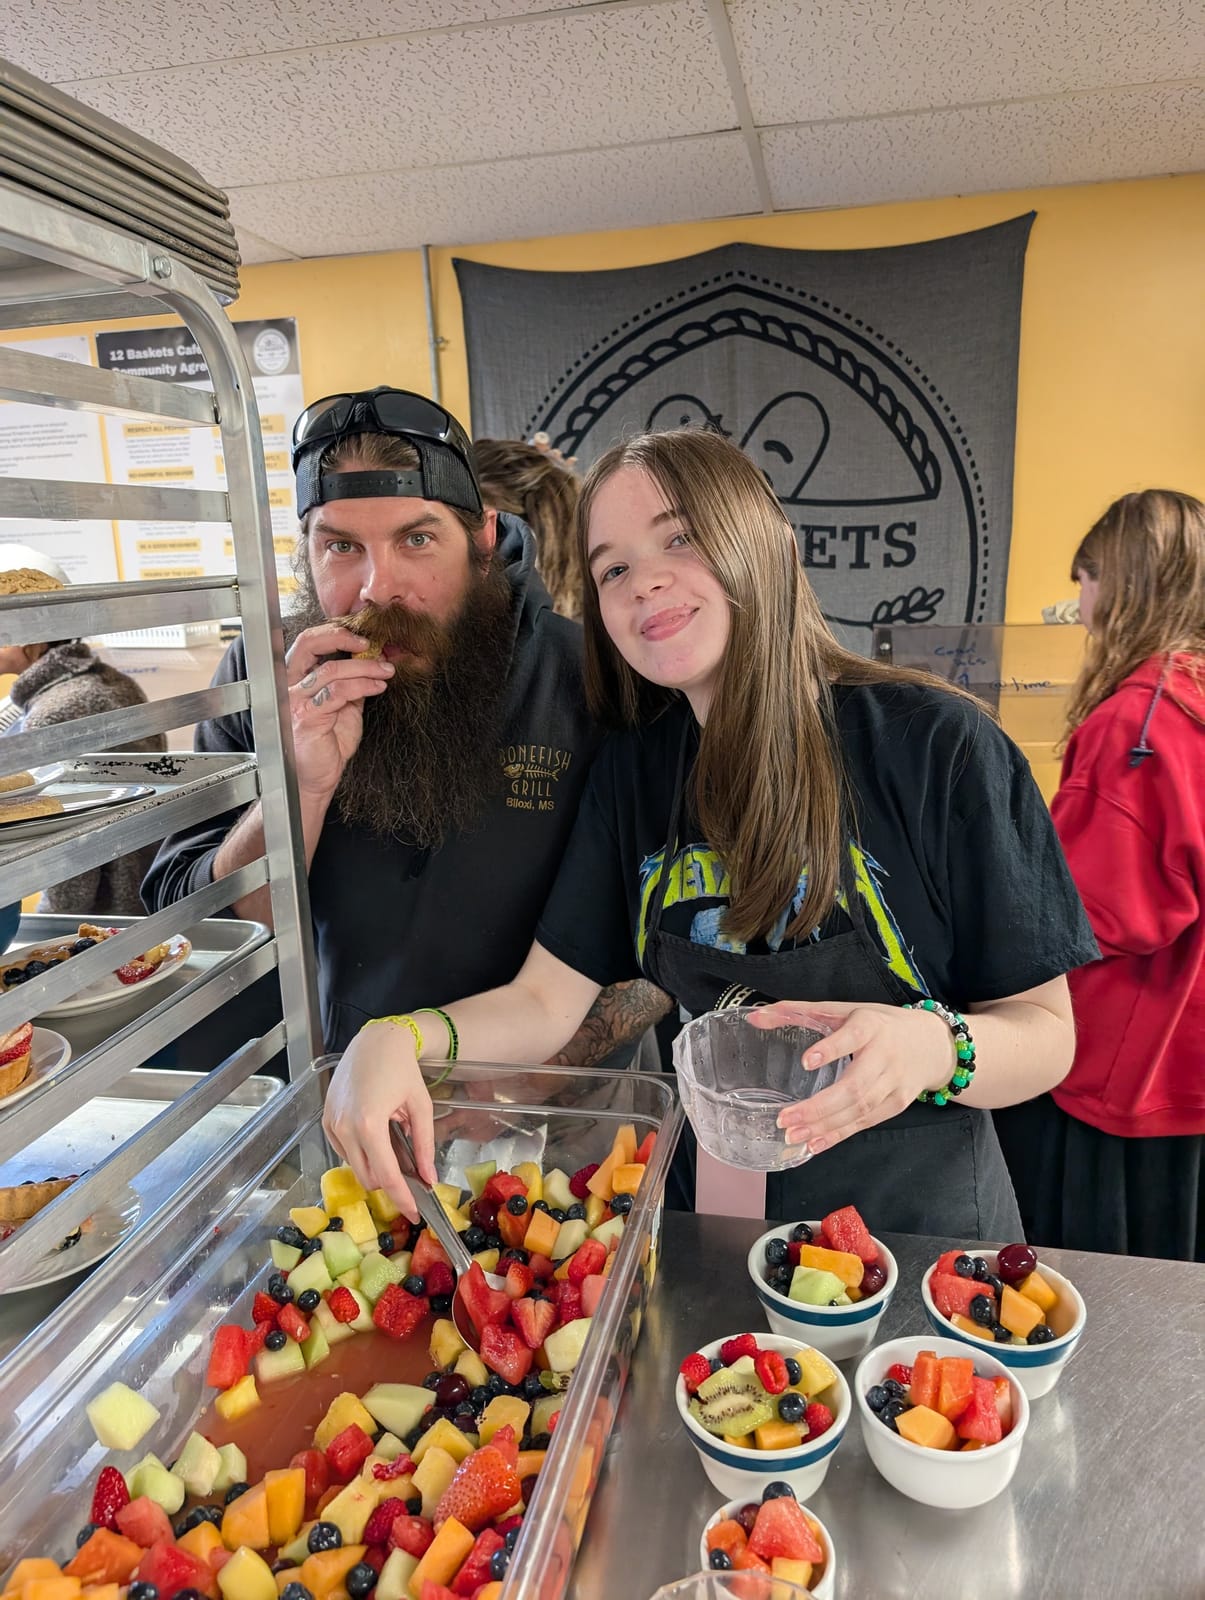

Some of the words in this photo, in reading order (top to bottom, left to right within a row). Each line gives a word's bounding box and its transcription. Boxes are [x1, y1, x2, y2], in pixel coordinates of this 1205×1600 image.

[109, 348, 125, 361] 12
[126, 346, 174, 360] Baskets
[511, 779, 552, 797] GRILL
[506, 797, 535, 811] Biloxi,
[538, 799, 555, 811] MS
